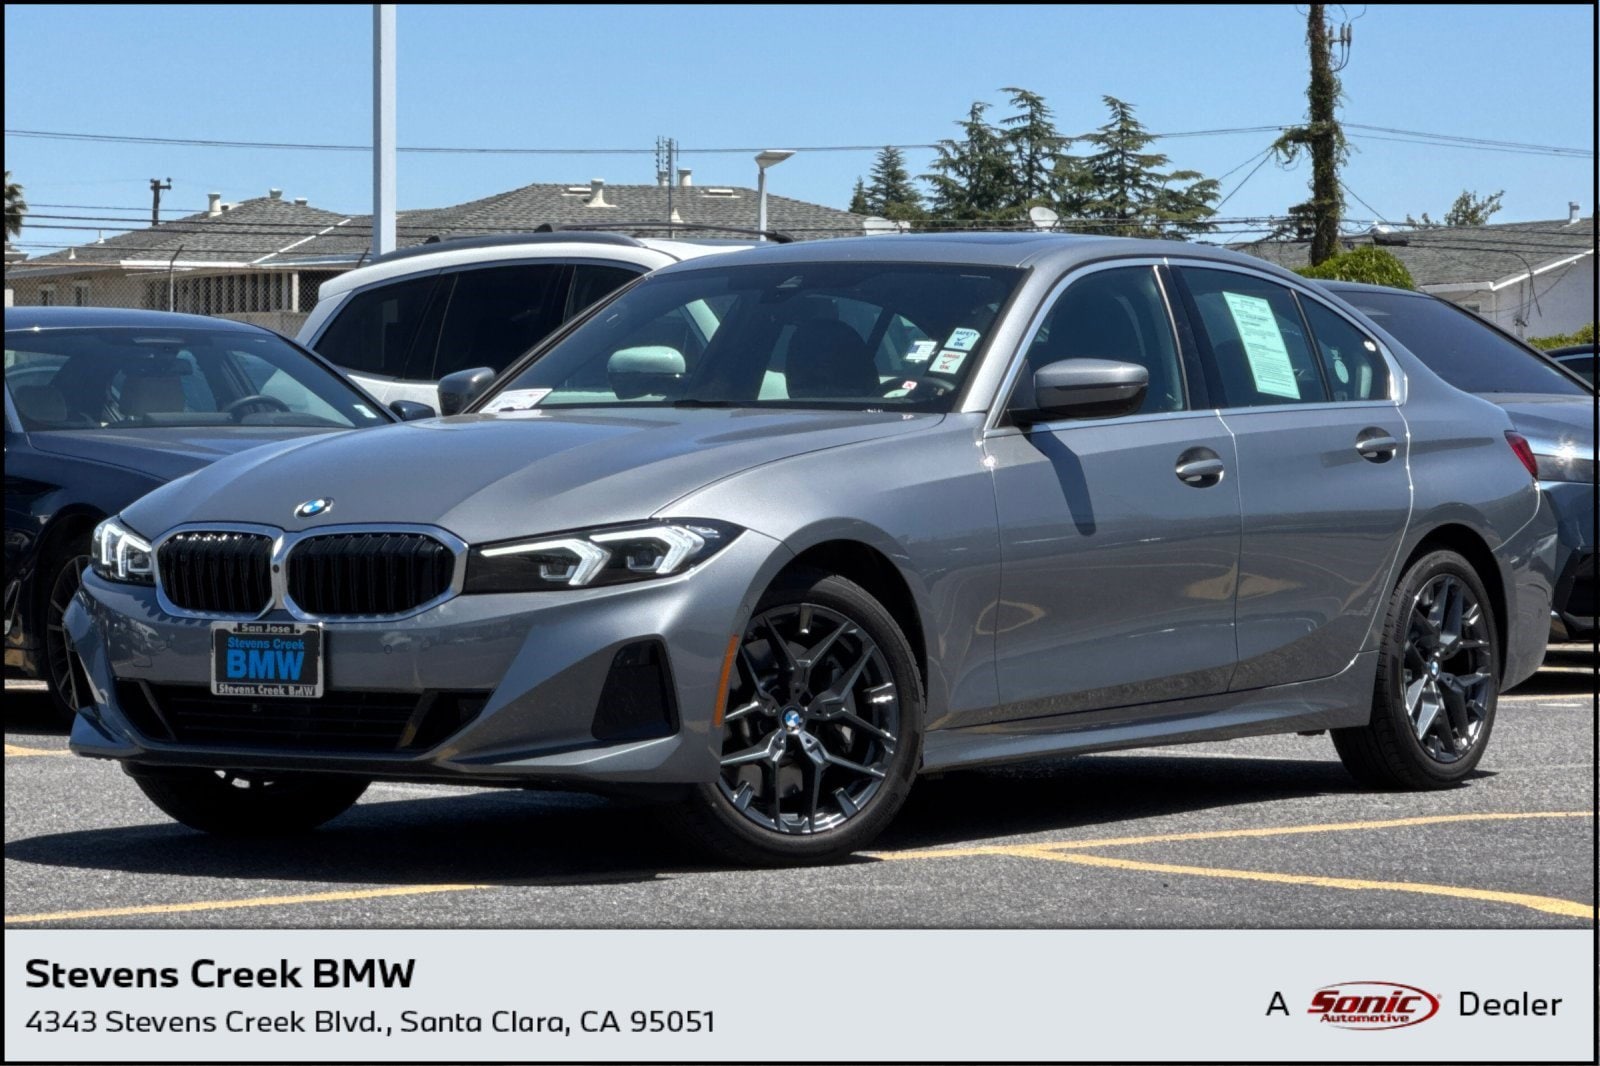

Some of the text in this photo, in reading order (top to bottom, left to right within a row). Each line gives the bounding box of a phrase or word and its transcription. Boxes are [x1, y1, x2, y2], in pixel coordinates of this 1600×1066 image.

[241, 623, 291, 633] San Jose
[227, 636, 305, 650] Stevens Creek
[227, 649, 305, 680] BMW
[219, 684, 255, 694] Stevens
[258, 685, 285, 695] Creek
